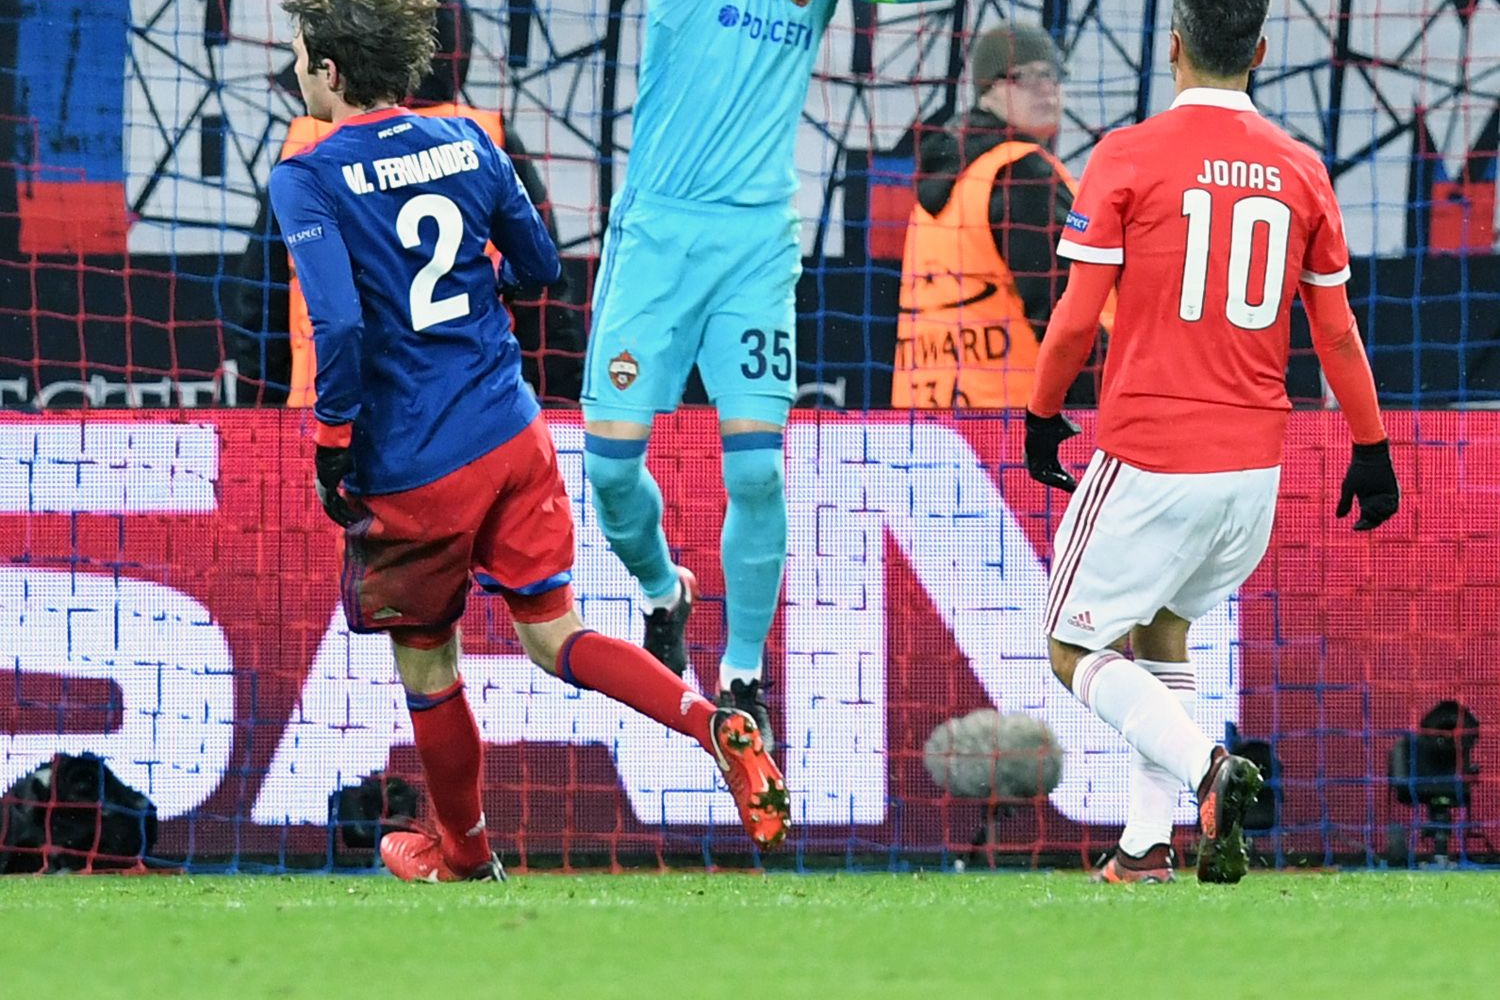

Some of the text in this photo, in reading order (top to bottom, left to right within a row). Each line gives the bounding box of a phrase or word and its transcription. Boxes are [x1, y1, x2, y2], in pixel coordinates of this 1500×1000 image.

[374, 140, 479, 191] FERNANDES
[1196, 159, 1282, 192] JONAS
[395, 193, 470, 333] 2
[1178, 187, 1292, 331] 10
[740, 328, 793, 382] 35
